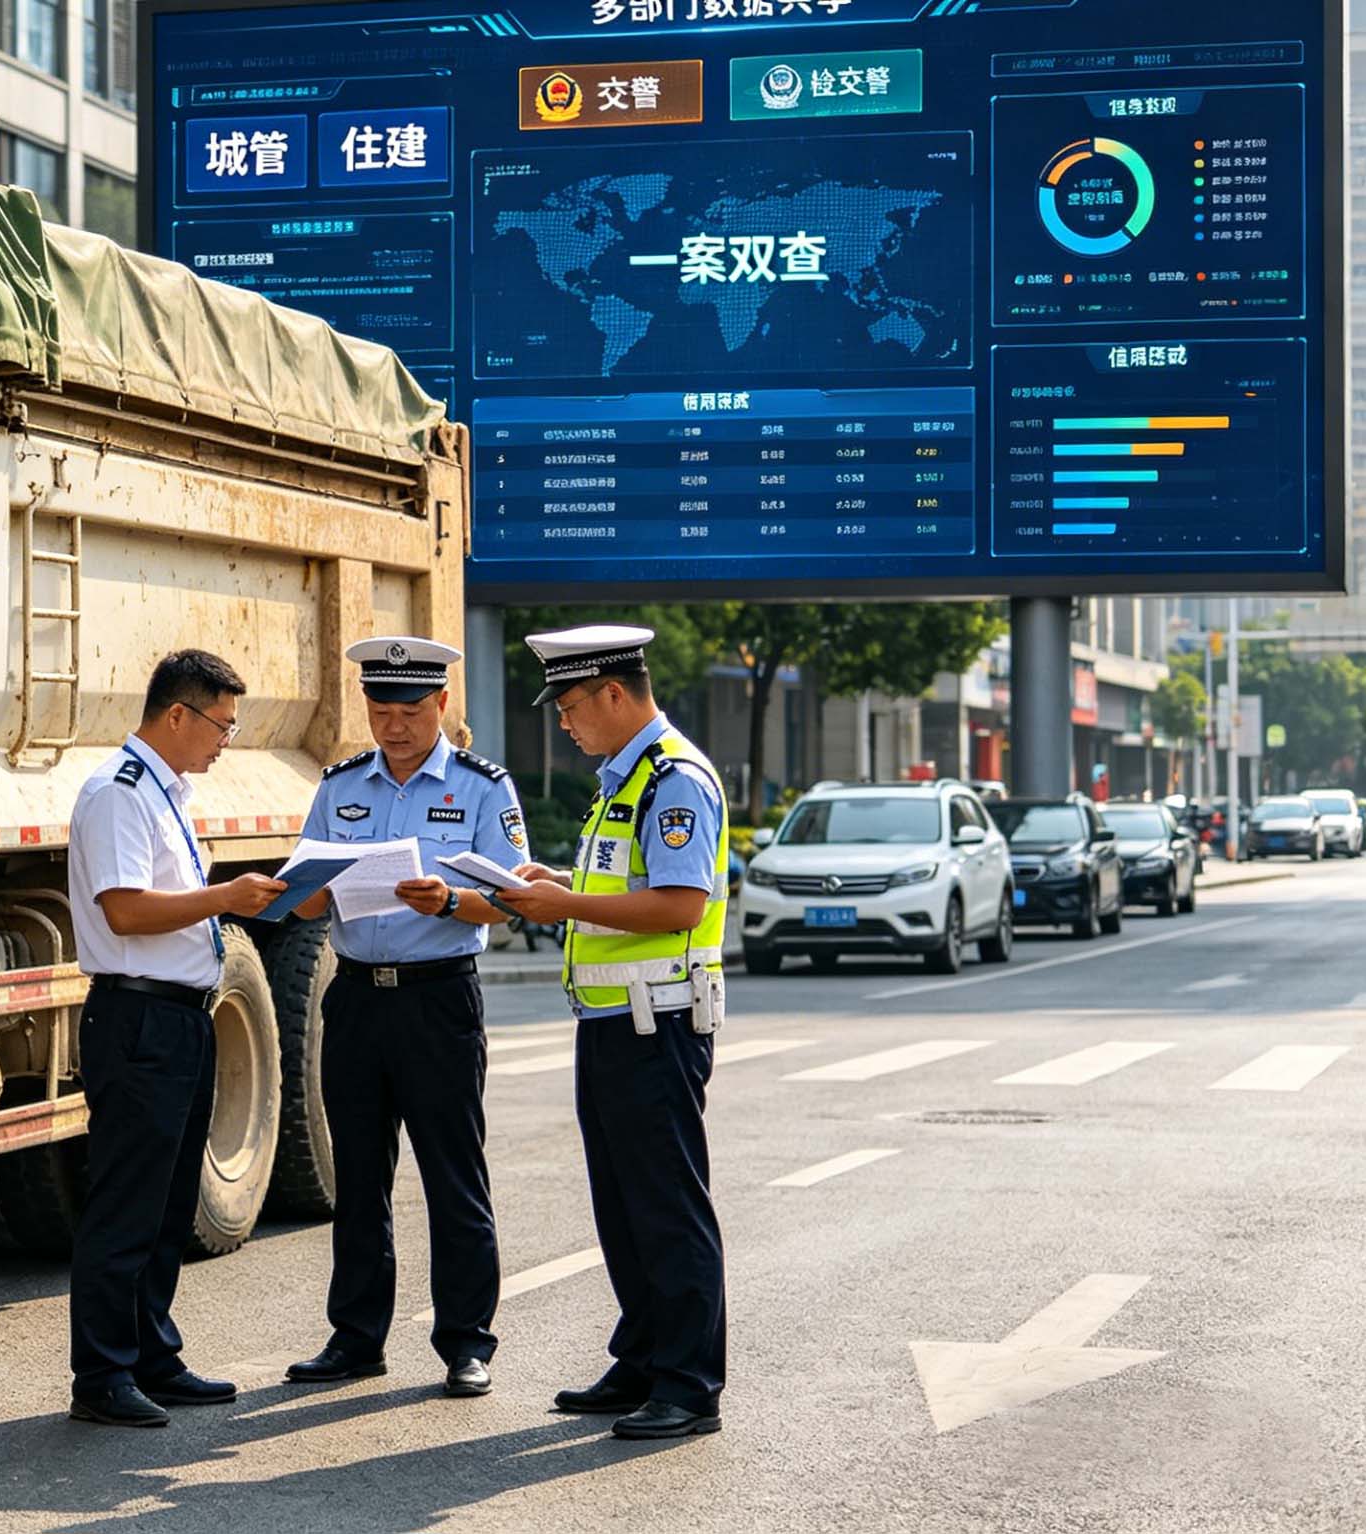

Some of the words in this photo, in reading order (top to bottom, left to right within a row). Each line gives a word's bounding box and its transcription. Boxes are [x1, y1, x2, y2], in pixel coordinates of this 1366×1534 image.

[597, 76, 660, 112] 交警
[205, 131, 288, 177] 城管
[340, 123, 427, 172] 住建
[629, 231, 830, 284] 一案双查
